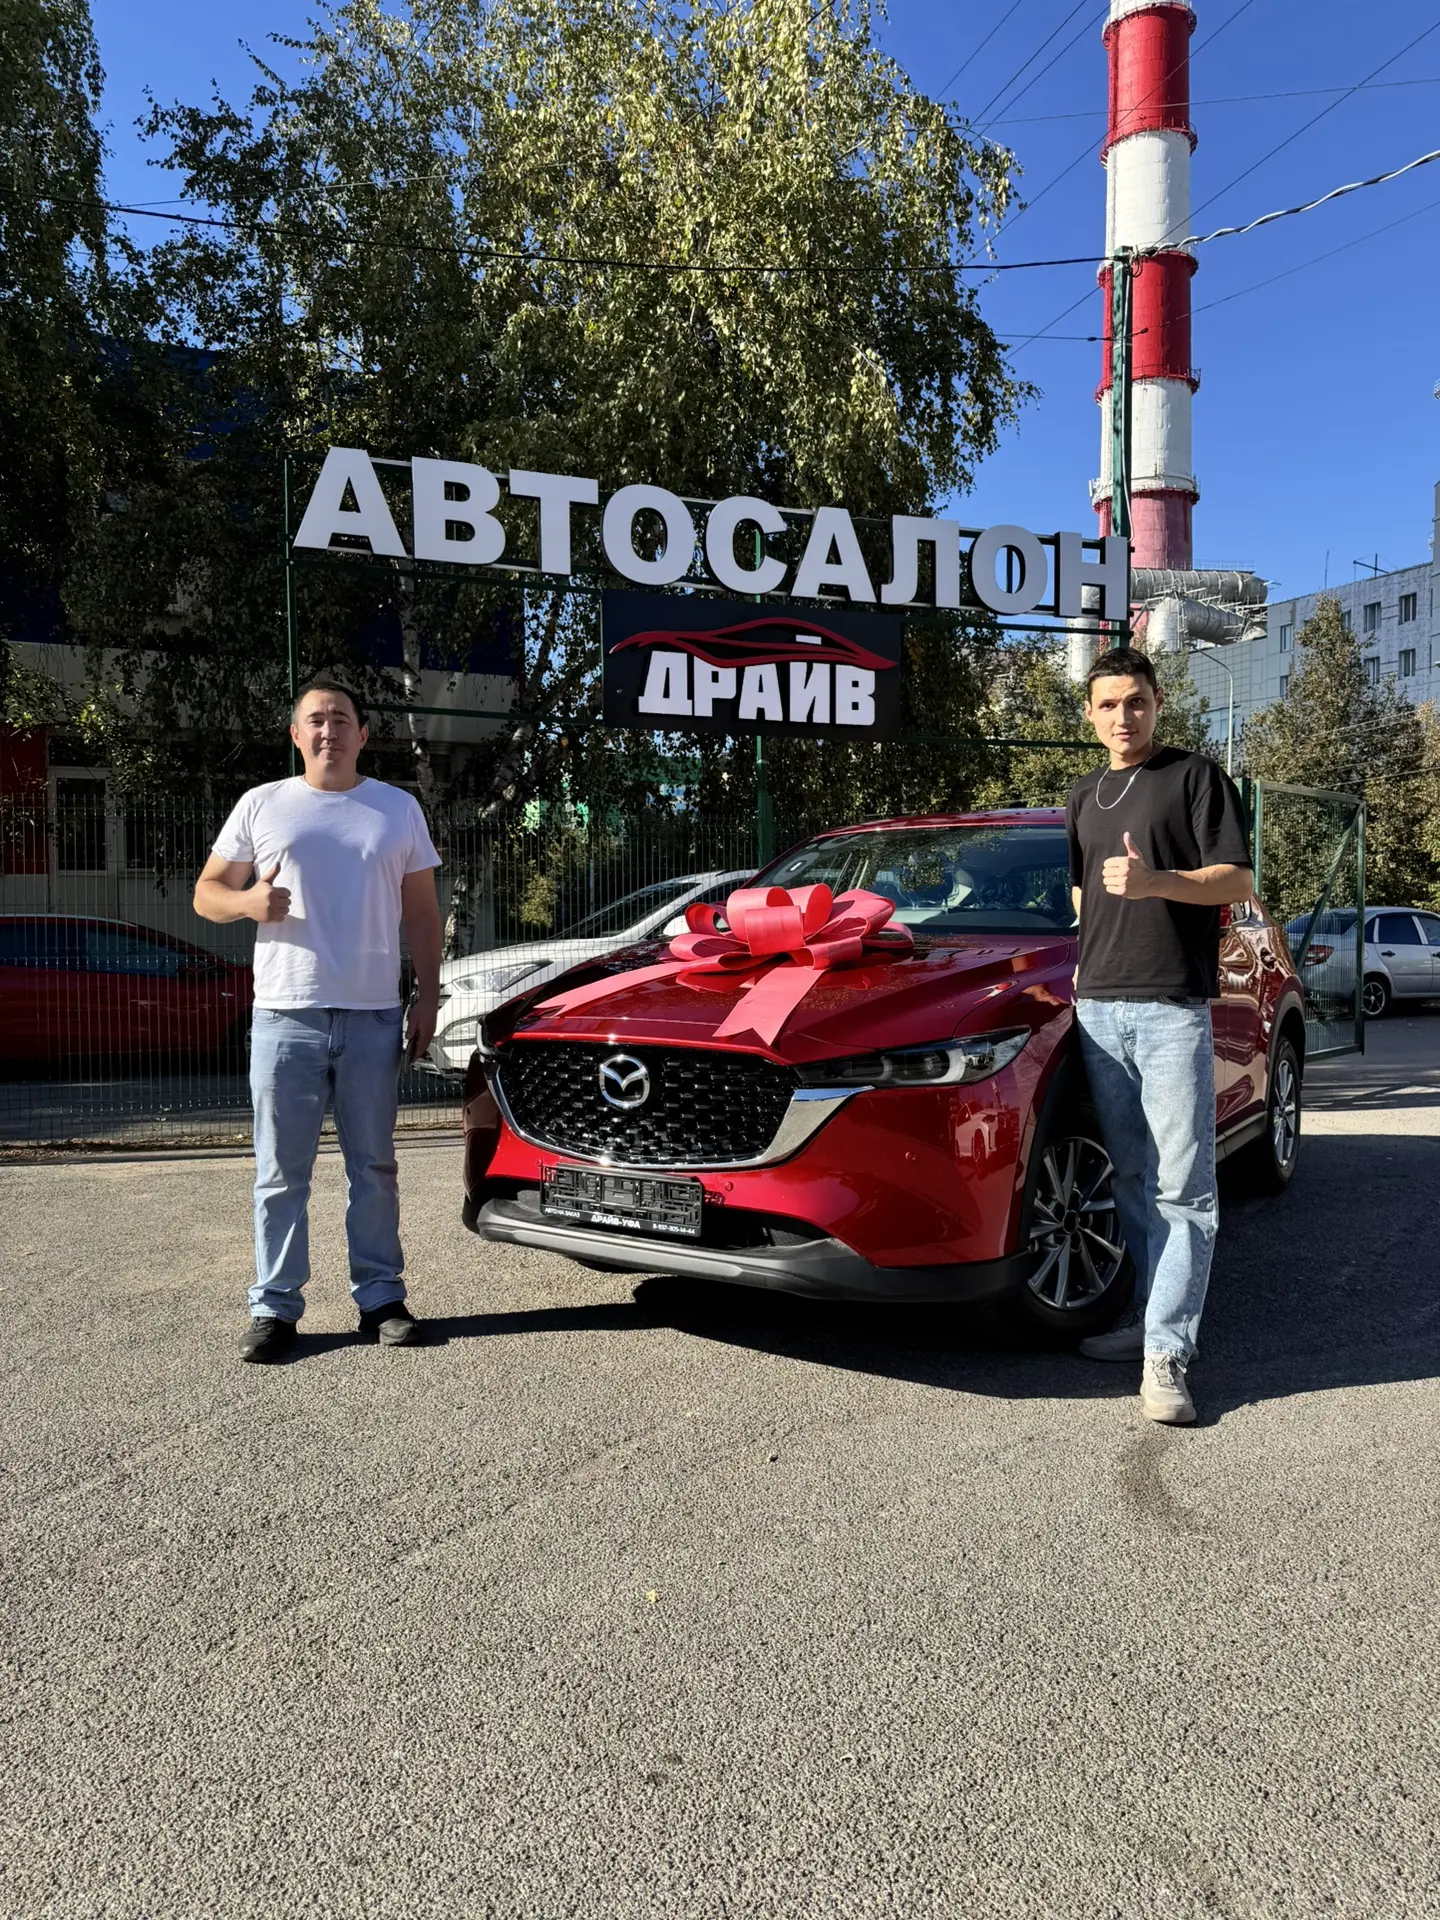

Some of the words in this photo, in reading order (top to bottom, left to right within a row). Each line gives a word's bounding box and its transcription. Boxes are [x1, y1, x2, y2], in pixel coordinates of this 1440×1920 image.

[294, 446, 1130, 621] АВТОСАЛОН
[638, 634, 876, 726] ДРАЙВ
[590, 1214, 641, 1229] ДРАЙВ-УФА
